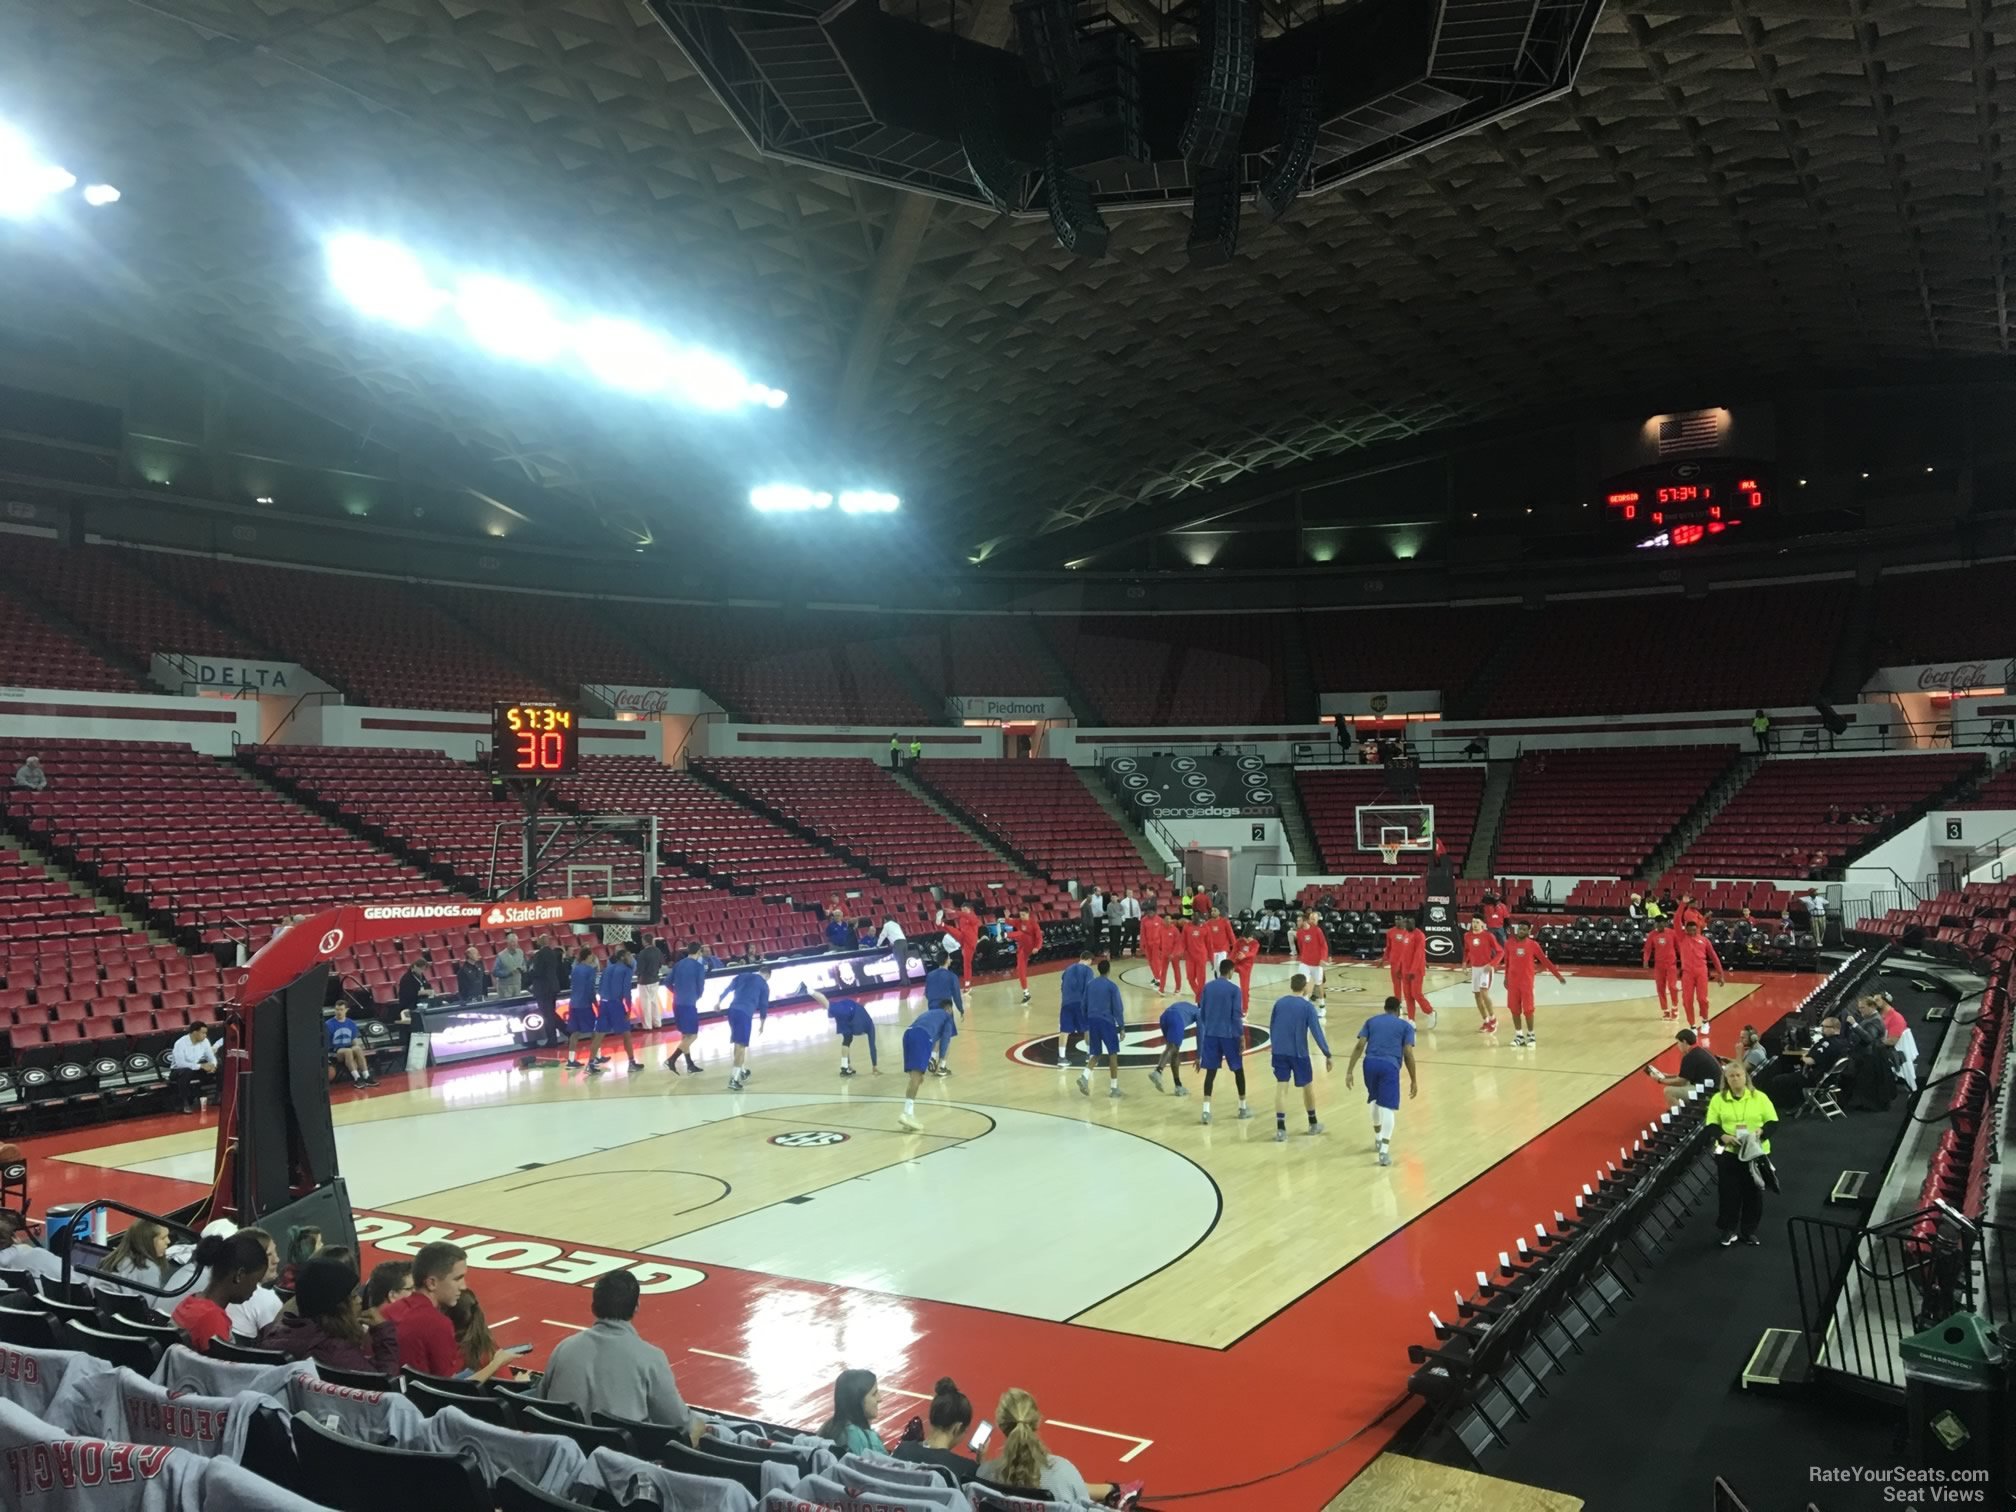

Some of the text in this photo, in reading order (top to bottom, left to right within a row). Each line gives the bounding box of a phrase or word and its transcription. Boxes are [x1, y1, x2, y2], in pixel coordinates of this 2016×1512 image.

[1609, 493, 1639, 503] GEORGIA
[1659, 486, 1697, 503] 57:34
[1752, 492, 1762, 506] 0
[1626, 505, 1635, 519] 0
[1653, 512, 1663, 524] 4
[1711, 506, 1721, 519] 4
[200, 665, 287, 688] DELTA
[987, 701, 1045, 714] Piedmont
[506, 708, 571, 731] 57:34
[516, 731, 563, 769] 30
[1153, 805, 1275, 818] georgiadogs.com
[1253, 829, 1263, 841] 2
[1950, 824, 1960, 839] 3
[364, 905, 482, 920] GEORGIADOGS.COM
[351, 1215, 706, 1295] GEORG
